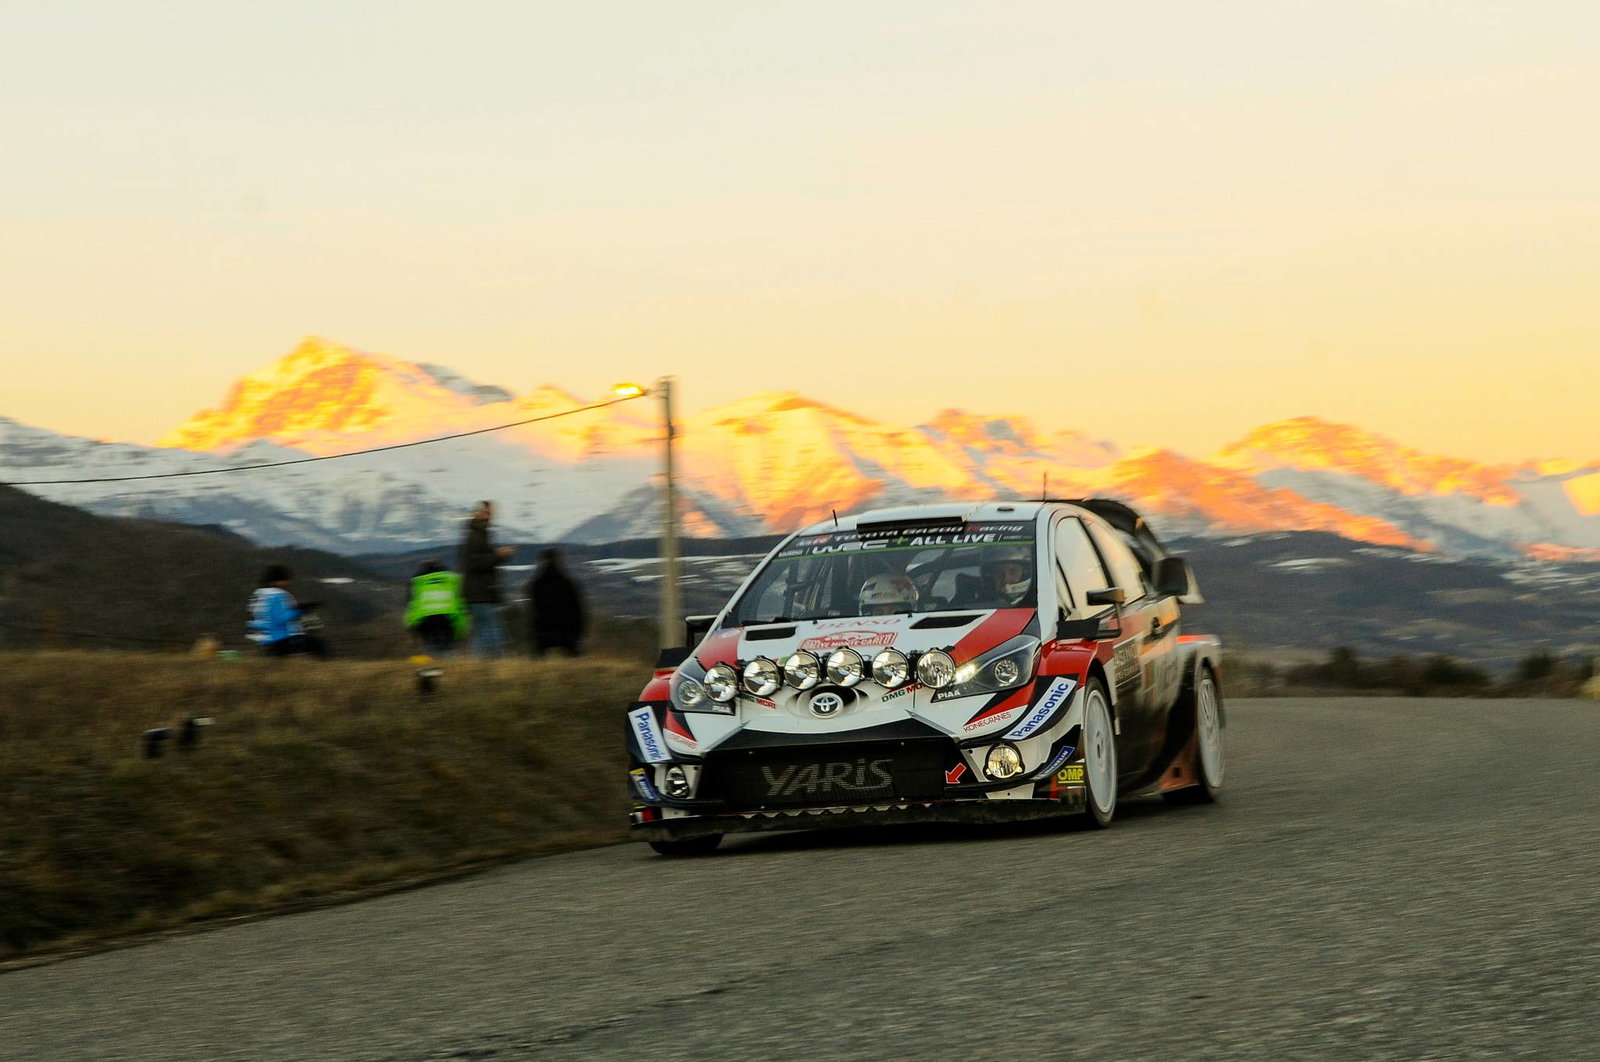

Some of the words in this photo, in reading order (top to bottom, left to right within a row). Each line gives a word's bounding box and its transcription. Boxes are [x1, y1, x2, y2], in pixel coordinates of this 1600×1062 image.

[909, 536, 946, 547] ALL
[952, 533, 996, 544] LIVE
[881, 689, 905, 703] DMG
[755, 698, 776, 709] MORI
[1011, 682, 1069, 738] Panasonic
[963, 711, 1012, 733] KONECRANES
[635, 712, 664, 760] Panasonic
[1058, 768, 1084, 781] OMP
